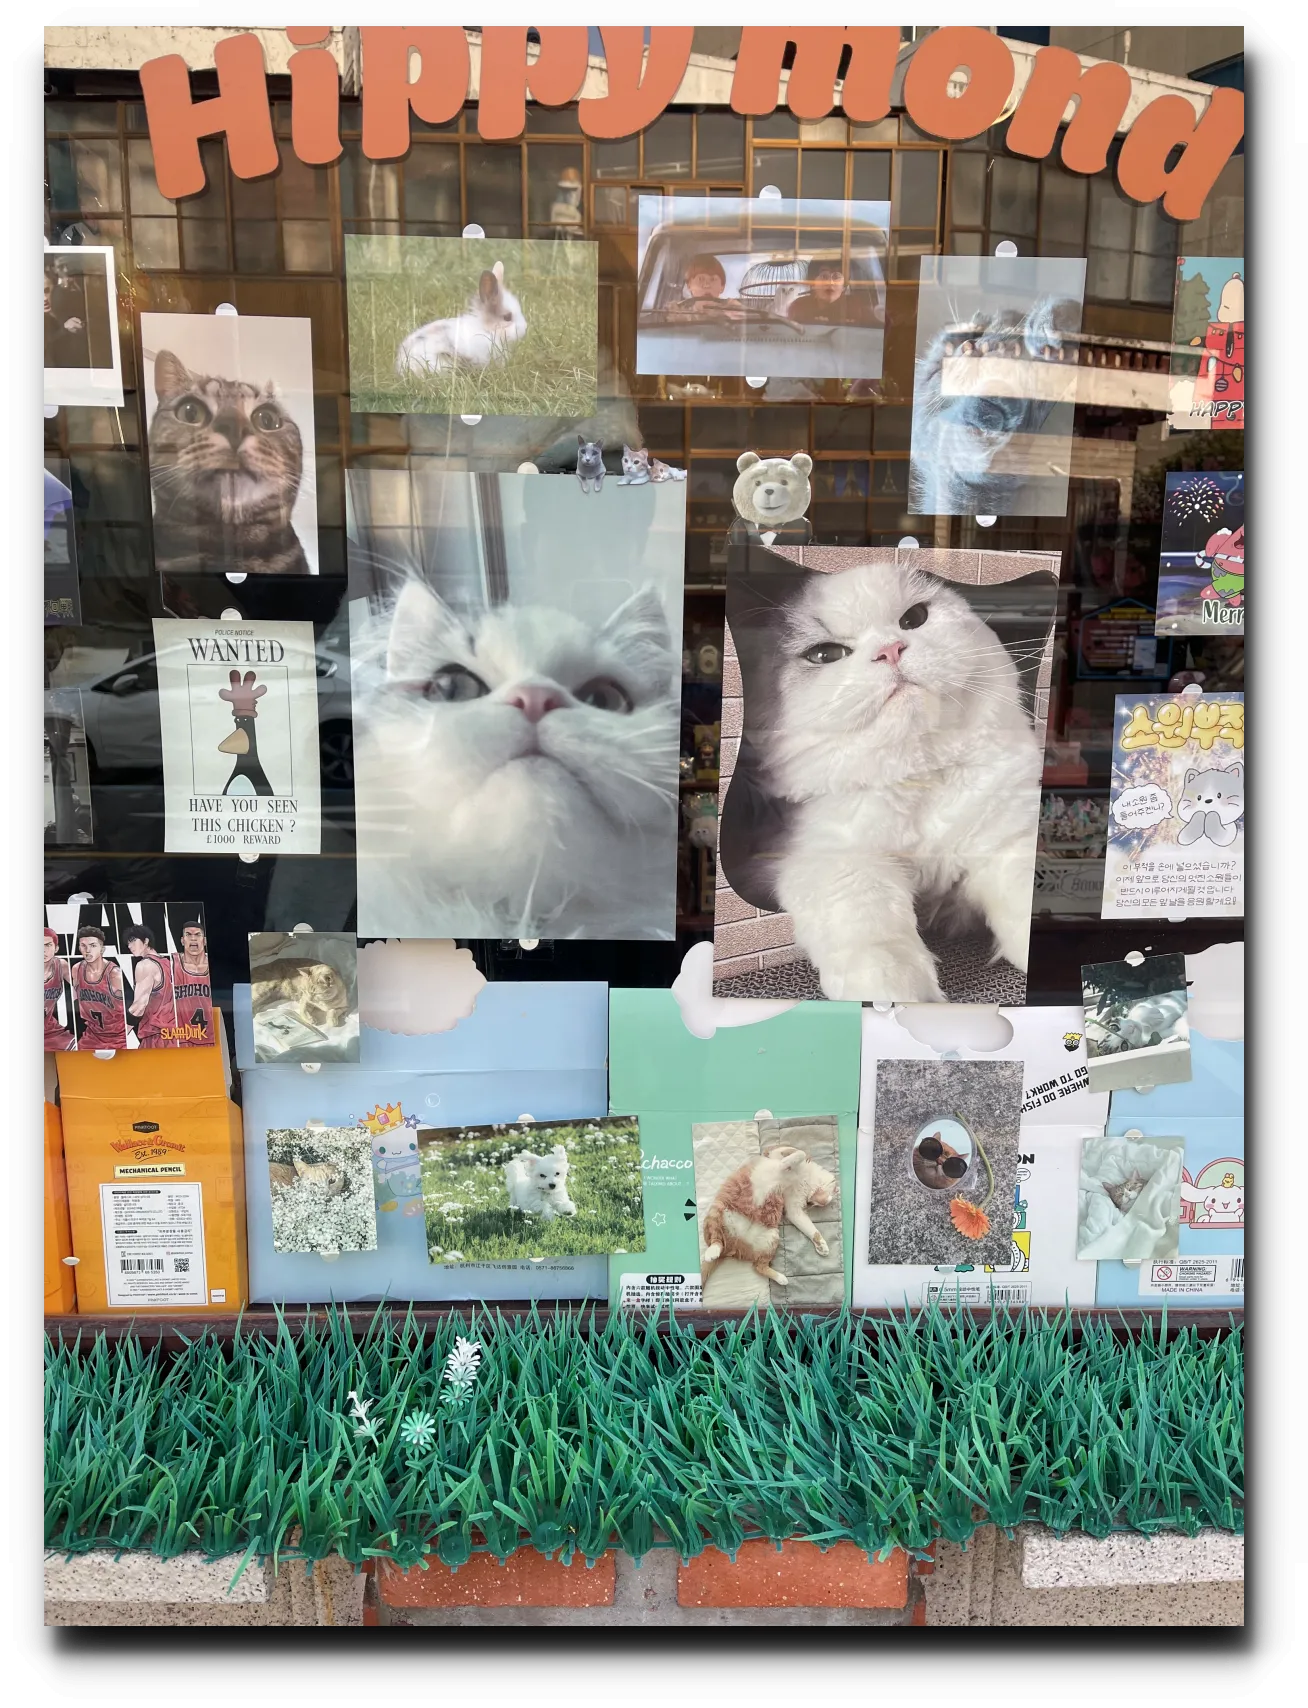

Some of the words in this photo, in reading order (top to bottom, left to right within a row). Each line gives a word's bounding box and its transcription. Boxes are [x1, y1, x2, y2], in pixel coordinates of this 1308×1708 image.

[1189, 401, 1244, 417] HAPP
[186, 637, 285, 663] WANTED
[189, 798, 223, 812] HAVE
[231, 799, 259, 813] YOU
[267, 800, 299, 813] SEEN
[192, 818, 222, 832] THIS
[227, 819, 284, 833] CHICKEN
[243, 835, 281, 845] REWARD
[90, 1009, 105, 1030] 7
